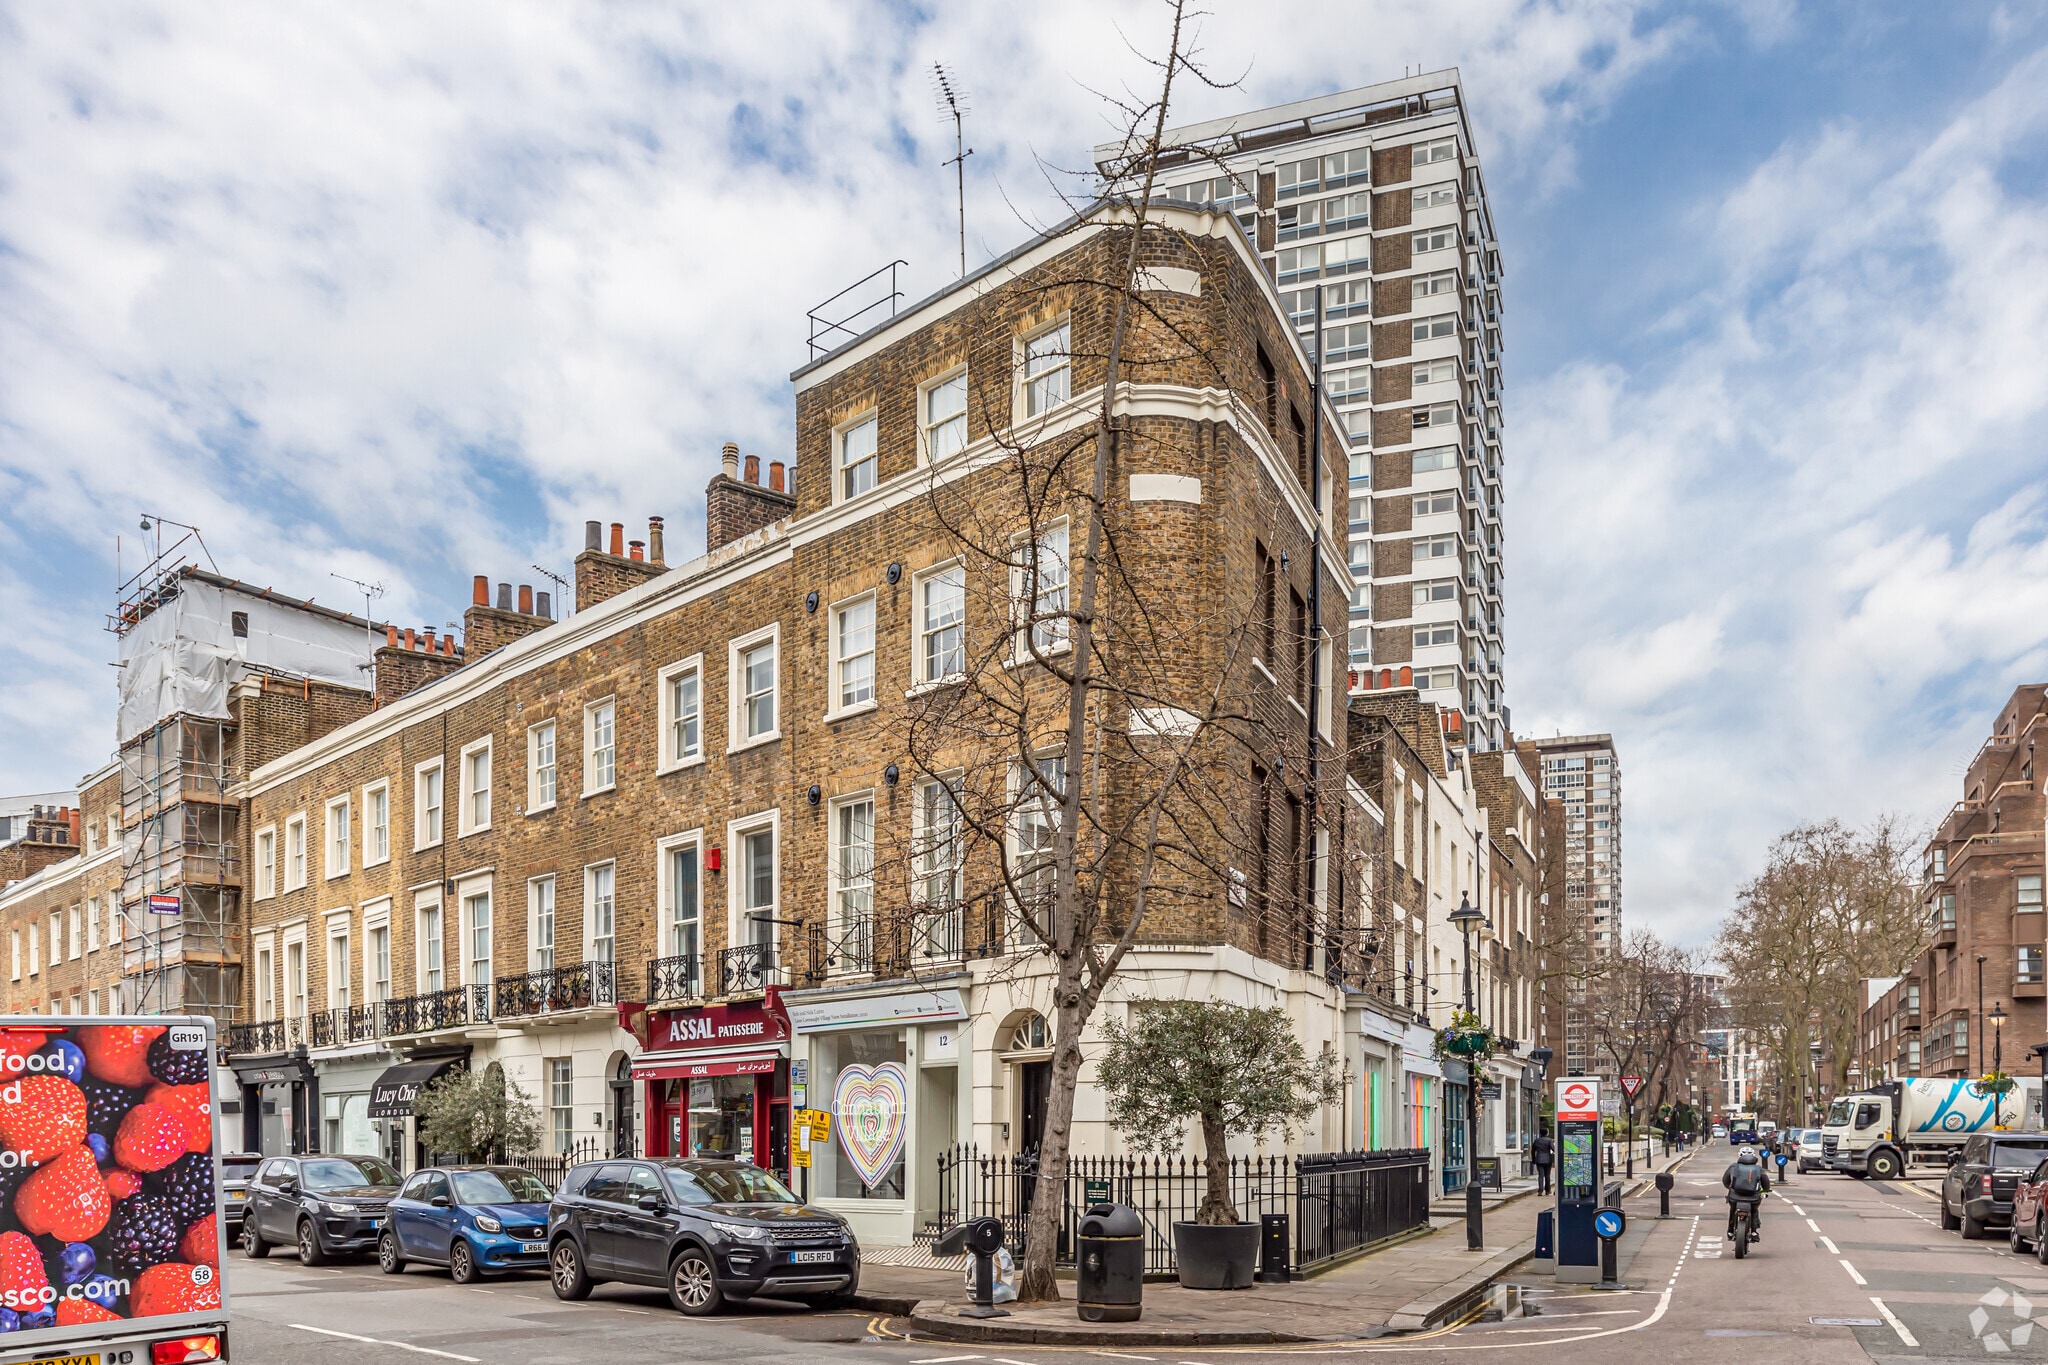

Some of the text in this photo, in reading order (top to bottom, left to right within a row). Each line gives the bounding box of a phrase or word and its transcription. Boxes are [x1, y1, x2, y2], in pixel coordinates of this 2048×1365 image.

[669, 1018, 764, 1042] ASSAL PATISSERIE
[172, 1033, 204, 1043] GR191
[939, 1035, 948, 1046] 12
[690, 1065, 708, 1075] ASSAL
[375, 1086, 397, 1107] Lucy
[375, 1109, 410, 1117] LONDON
[986, 1229, 992, 1237] 5
[523, 1243, 543, 1252] LR66
[797, 1253, 815, 1262] LC15
[195, 1269, 210, 1281] 58
[0, 1278, 131, 1308] sco.com
